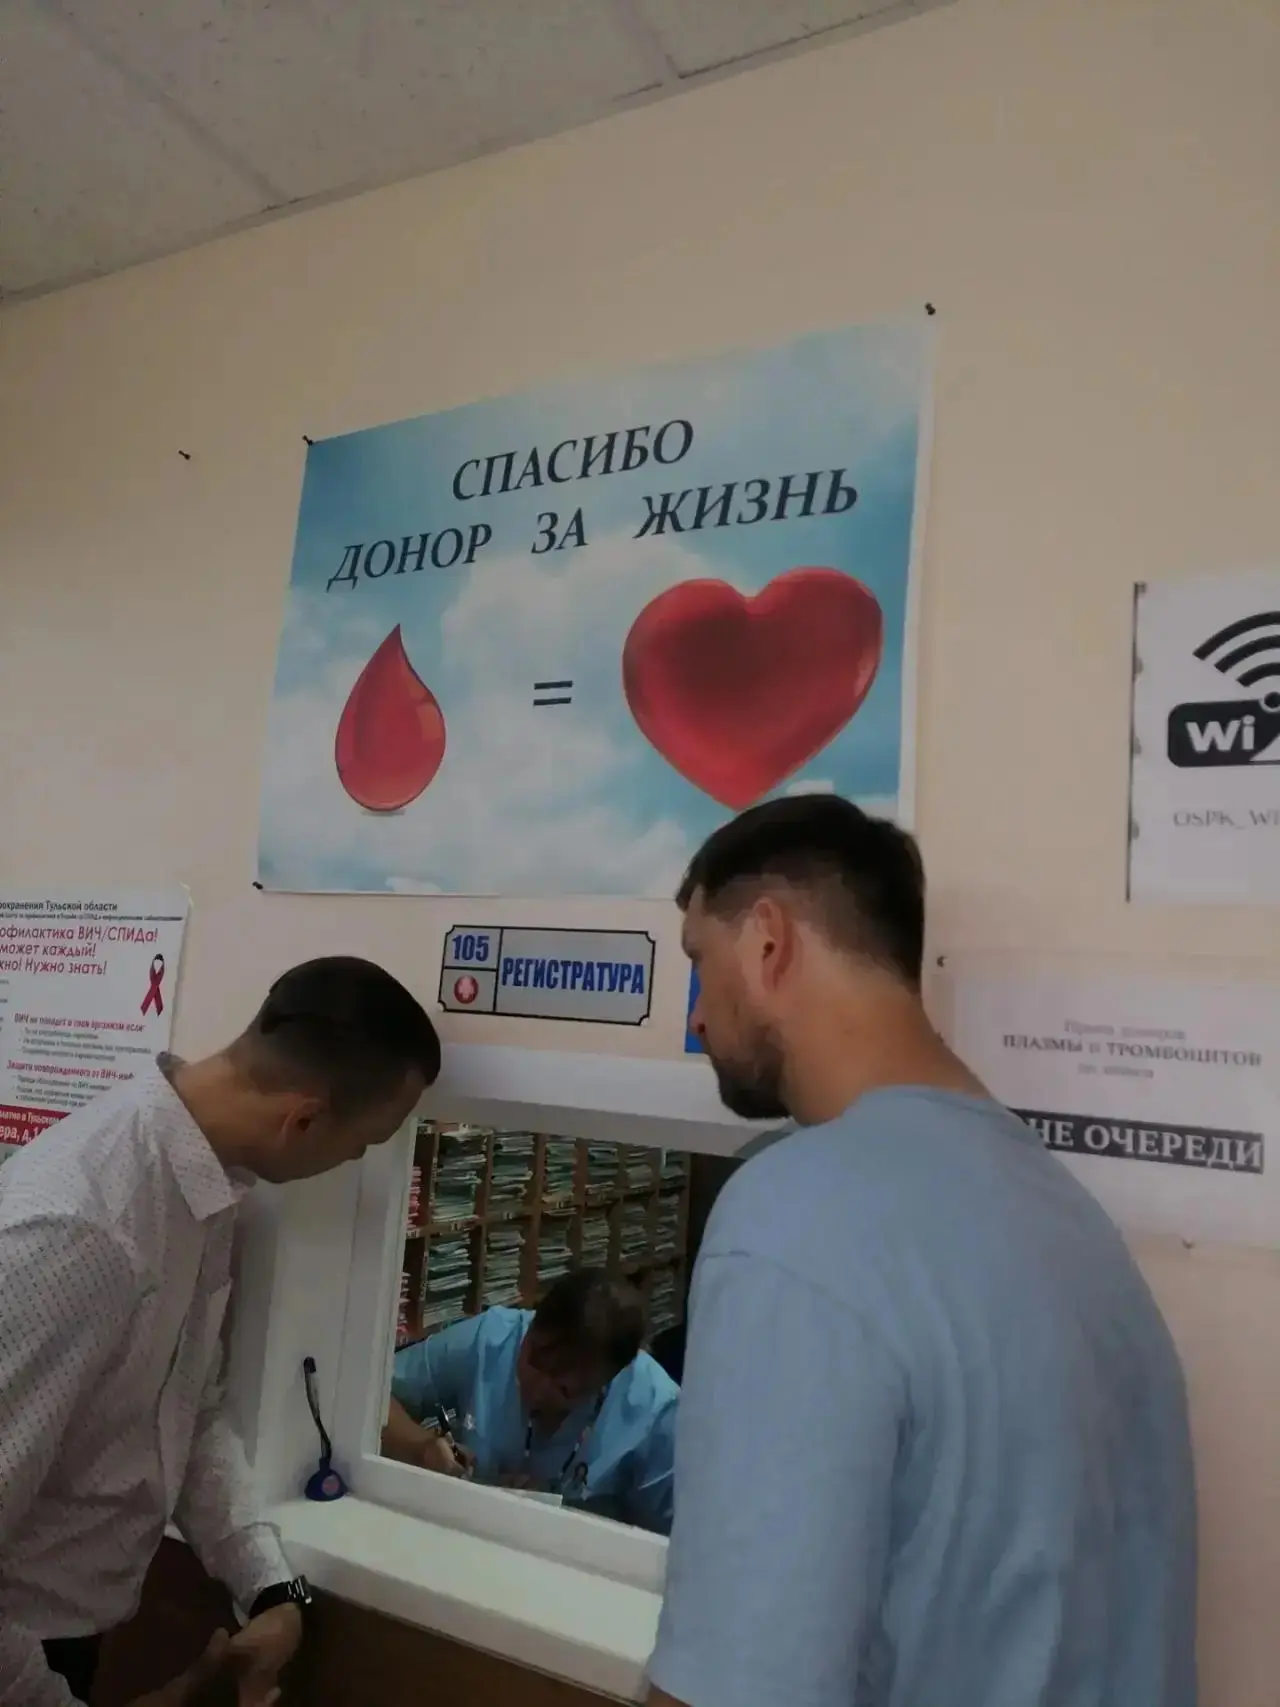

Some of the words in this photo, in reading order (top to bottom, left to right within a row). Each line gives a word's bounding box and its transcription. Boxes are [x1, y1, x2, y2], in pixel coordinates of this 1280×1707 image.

[453, 419, 694, 501] СПАСИБО
[327, 523, 492, 590] ДОНОР
[531, 507, 588, 554] ЗА
[633, 468, 859, 539] ЖИЗНЬ
[46, 900, 82, 913] Тульской
[84, 900, 118, 912] области
[0, 943, 39, 955] может
[42, 943, 96, 958] каждый!
[78, 926, 159, 944] ВИЧ/СПИДа!
[452, 934, 490, 962] 105
[25, 958, 65, 975] Нужно
[68, 960, 107, 976] знать!
[502, 957, 645, 994] РЕГИСТРАТУРА
[1003, 1034, 1082, 1054] ПЛАЗМЫ
[1106, 1042, 1262, 1068] ТРОМБОЦИТОВ
[1084, 1124, 1262, 1170] ОЧЕРЕДИ
